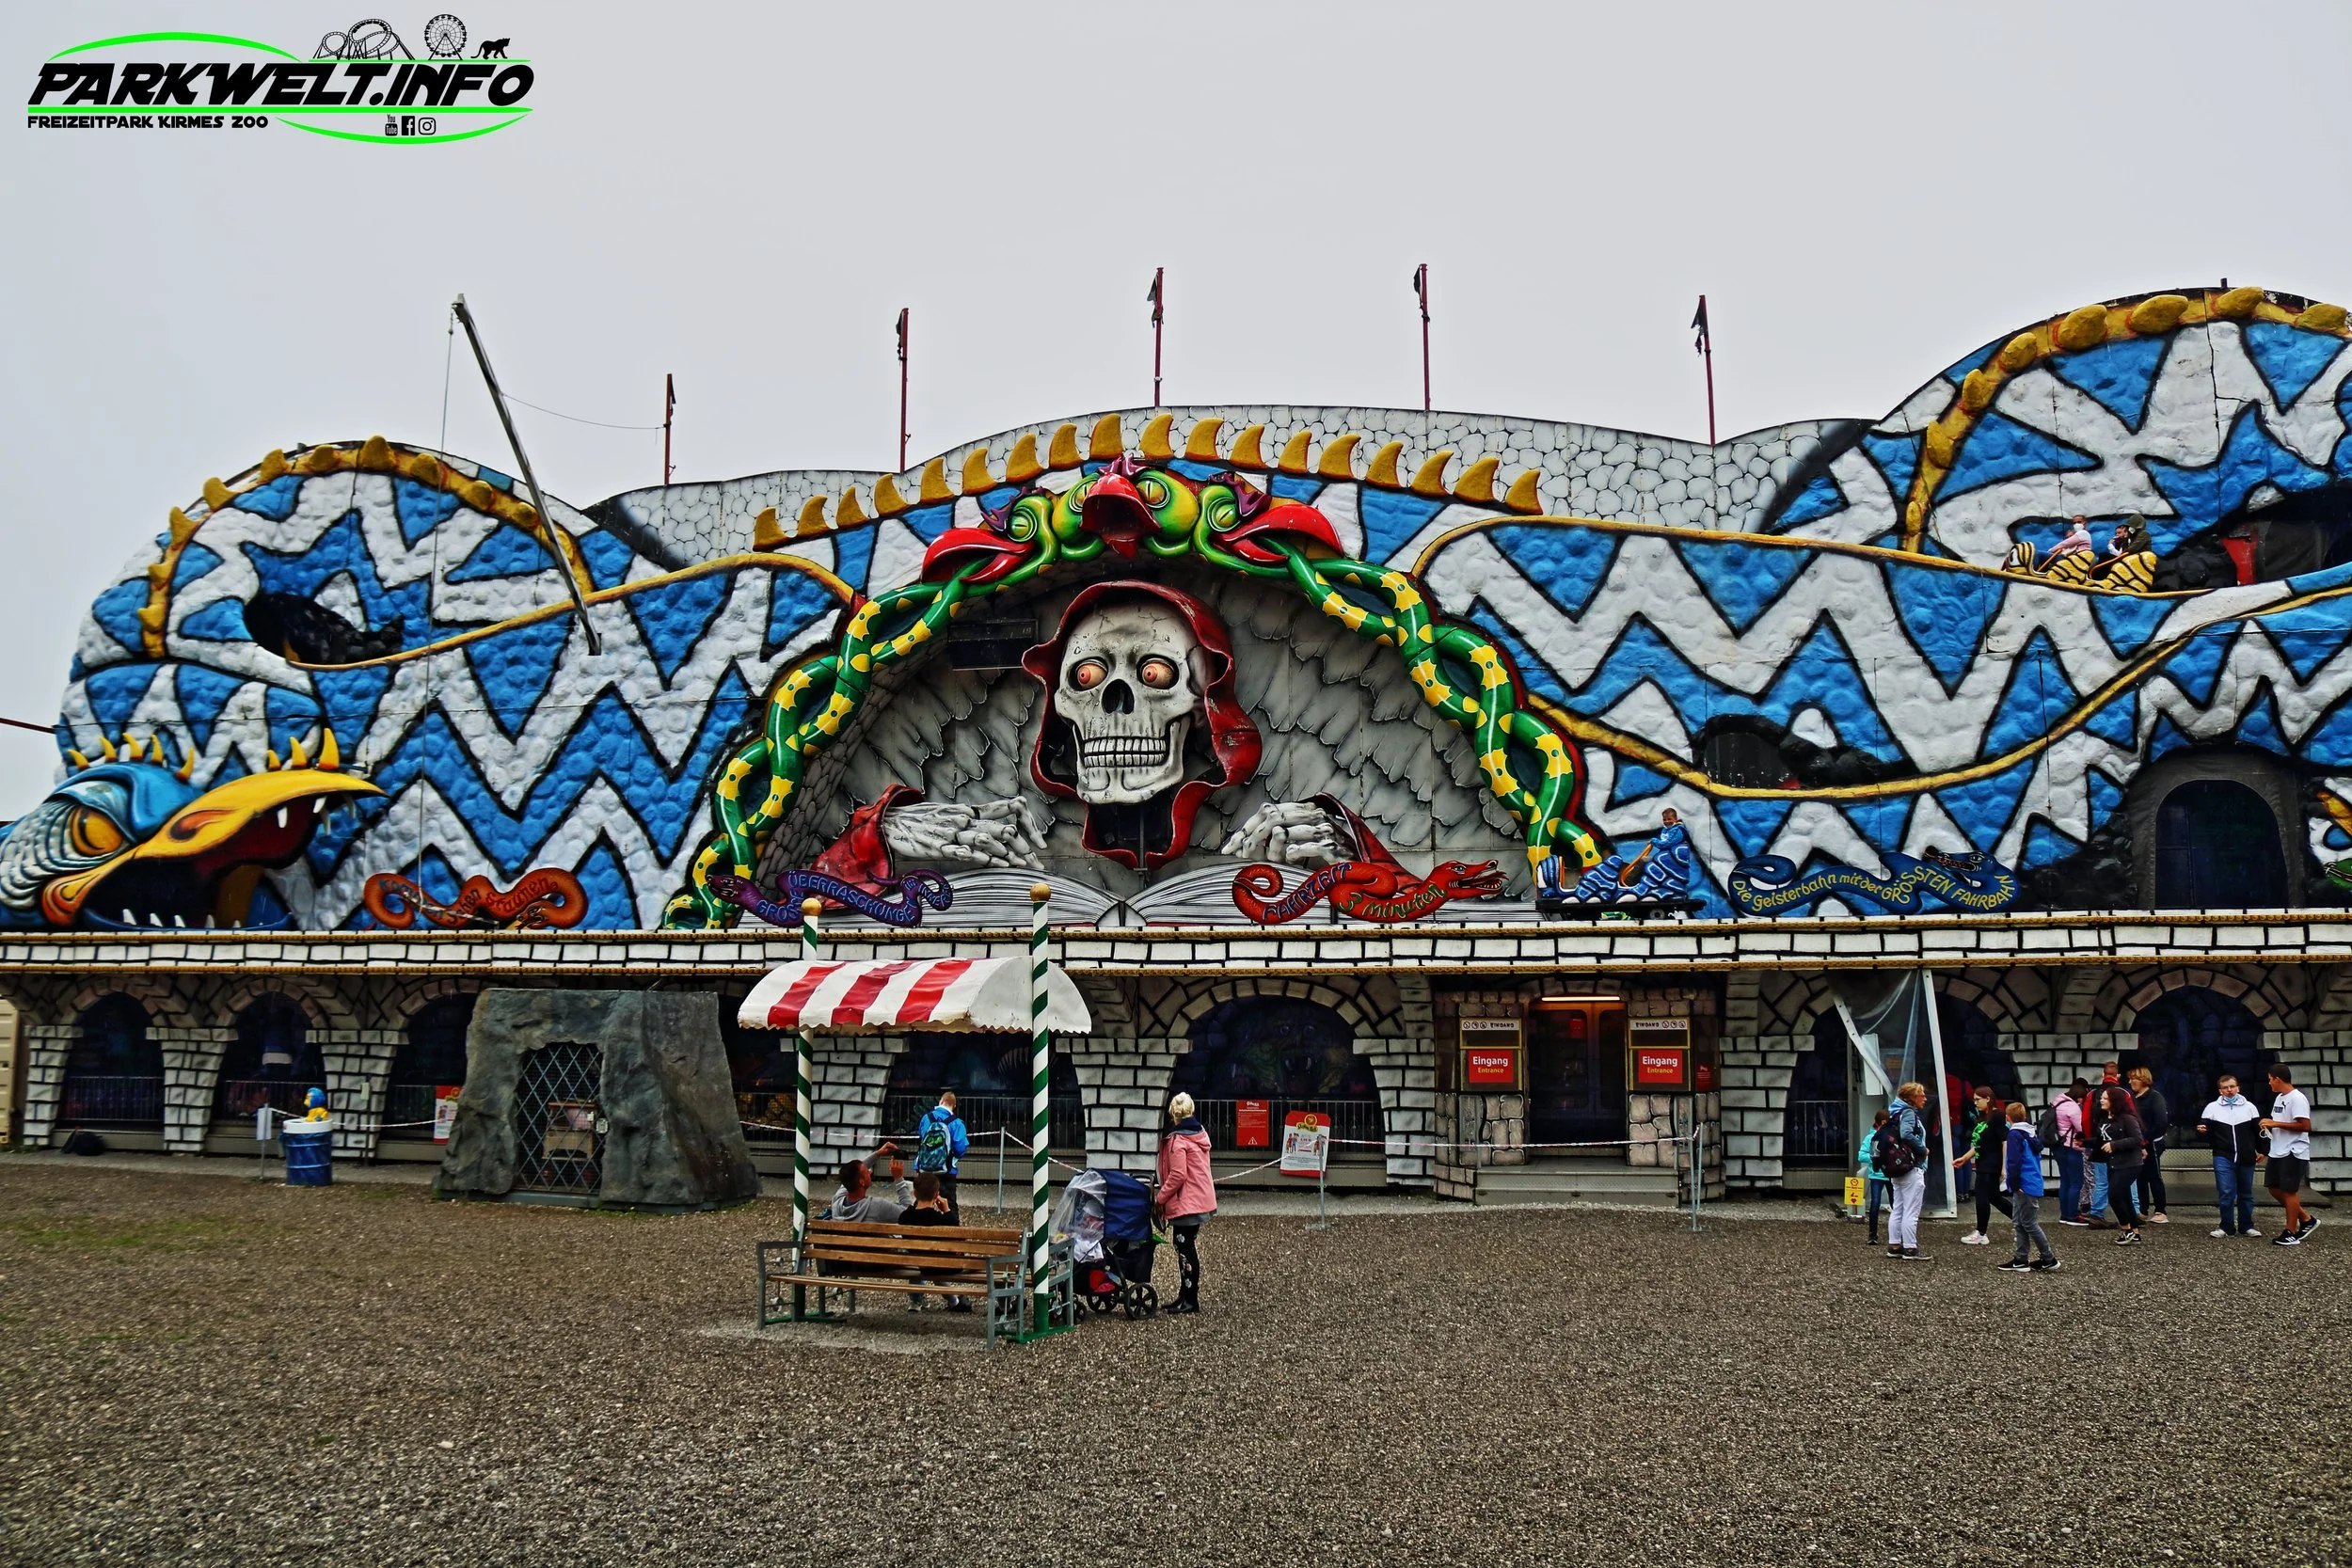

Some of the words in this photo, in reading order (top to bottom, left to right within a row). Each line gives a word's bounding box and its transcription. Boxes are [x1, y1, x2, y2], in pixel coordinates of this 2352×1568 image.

[1732, 880, 1752, 902] Die
[1751, 874, 1836, 912] Geisterbahn
[1839, 872, 1863, 885] mit
[1858, 876, 1883, 894] der
[1882, 865, 1956, 904] GRÖSSTEN
[1950, 875, 2015, 911] FAHRBAHN
[1337, 892, 1362, 911] 3
[1472, 1055, 1509, 1067] Eingang
[1642, 1055, 1678, 1067] Eingang
